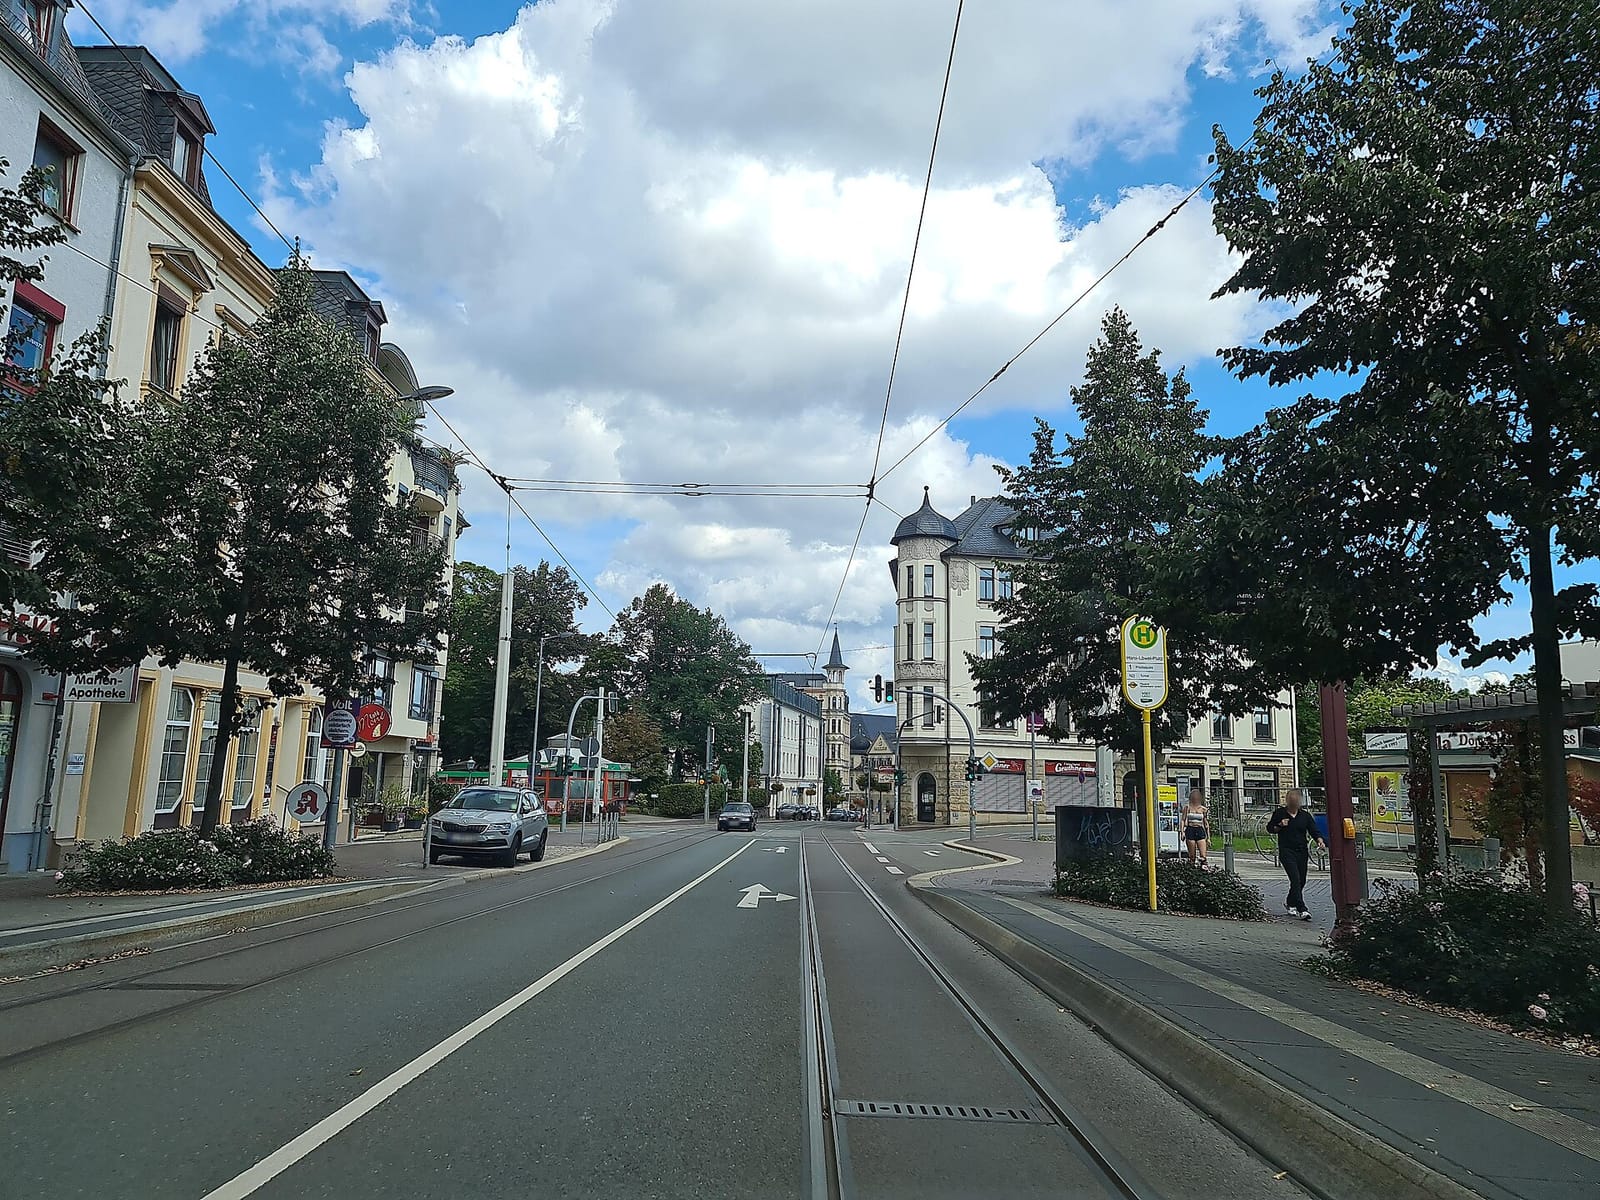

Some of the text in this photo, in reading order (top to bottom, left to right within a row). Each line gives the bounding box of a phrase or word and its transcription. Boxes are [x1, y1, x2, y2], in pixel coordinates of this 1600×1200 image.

[74, 674, 123, 686] Marien-
[68, 687, 126, 700] Apotheke
[332, 700, 353, 710] Volt
